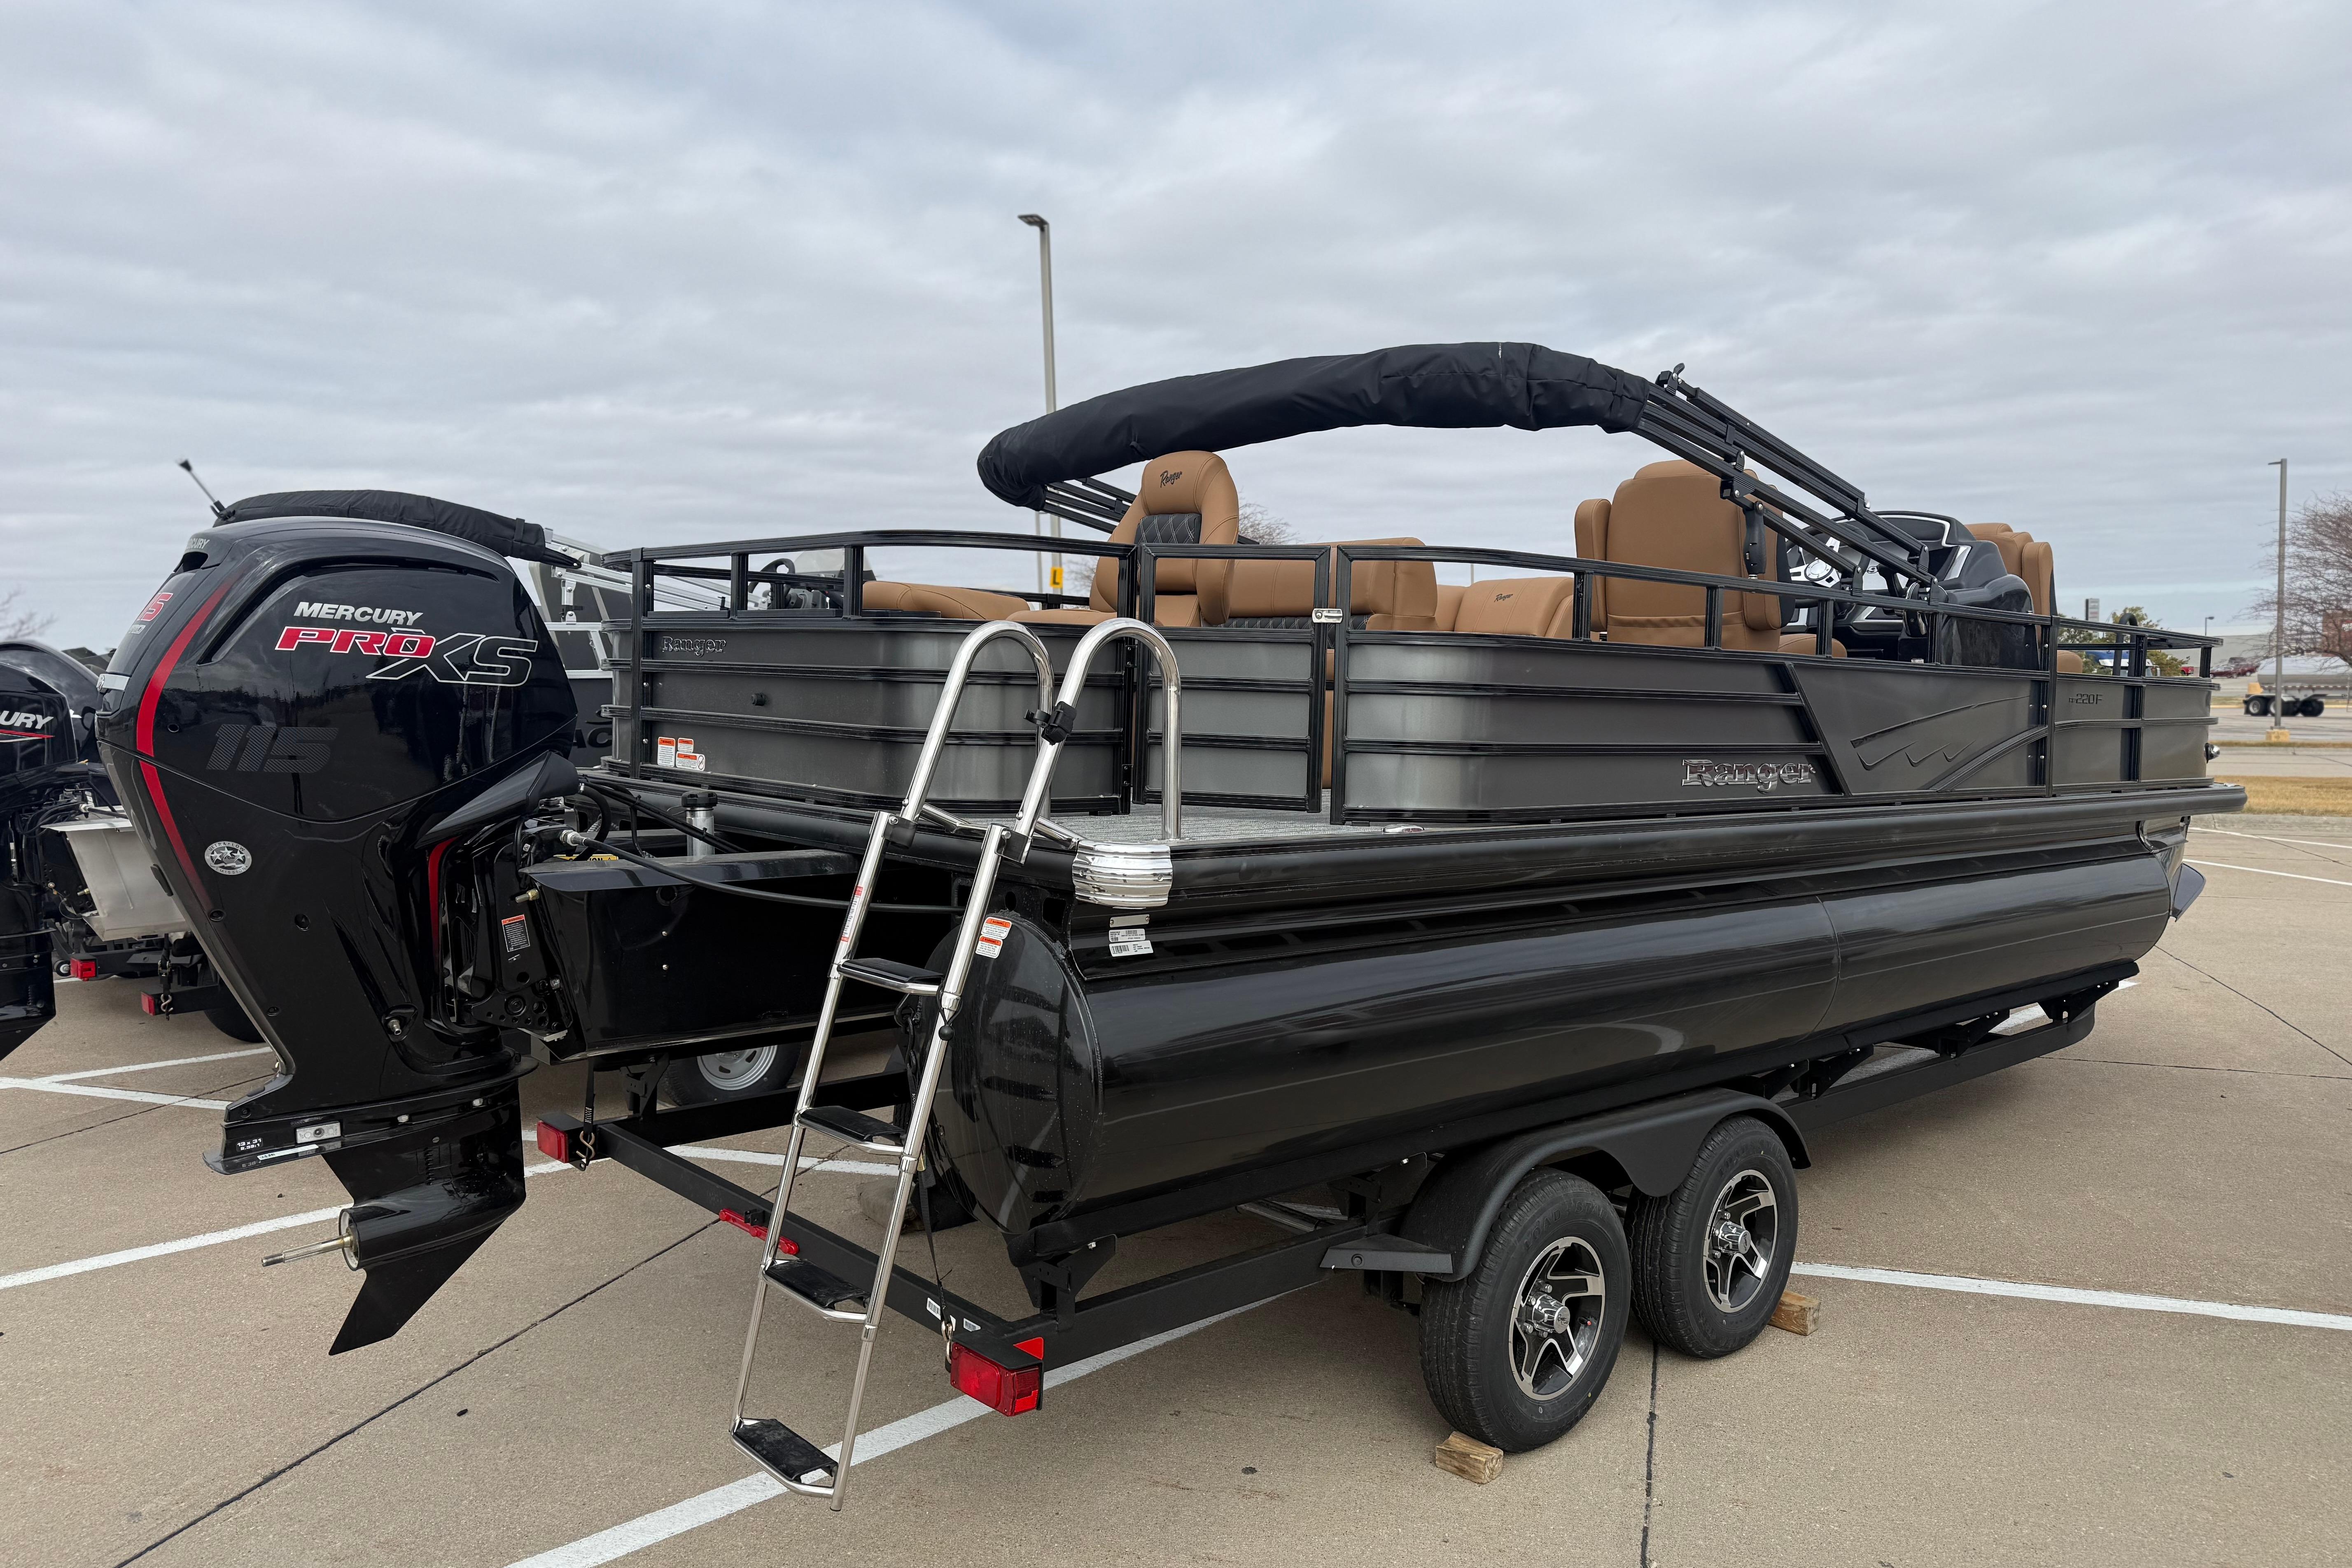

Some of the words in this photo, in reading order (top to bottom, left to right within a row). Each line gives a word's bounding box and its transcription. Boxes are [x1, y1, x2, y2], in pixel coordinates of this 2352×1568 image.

[1160, 470, 1183, 488] Ranger
[1052, 569, 1060, 585] L
[293, 602, 423, 626] MERCURY
[275, 626, 436, 658] PRO
[366, 627, 539, 687] XS
[662, 636, 726, 657] Ranger
[0, 710, 54, 729] URY
[206, 724, 339, 773] 115
[1682, 759, 1815, 794] Ranger
[209, 842, 226, 851] ULTRA
[232, 843, 245, 851] LOW
